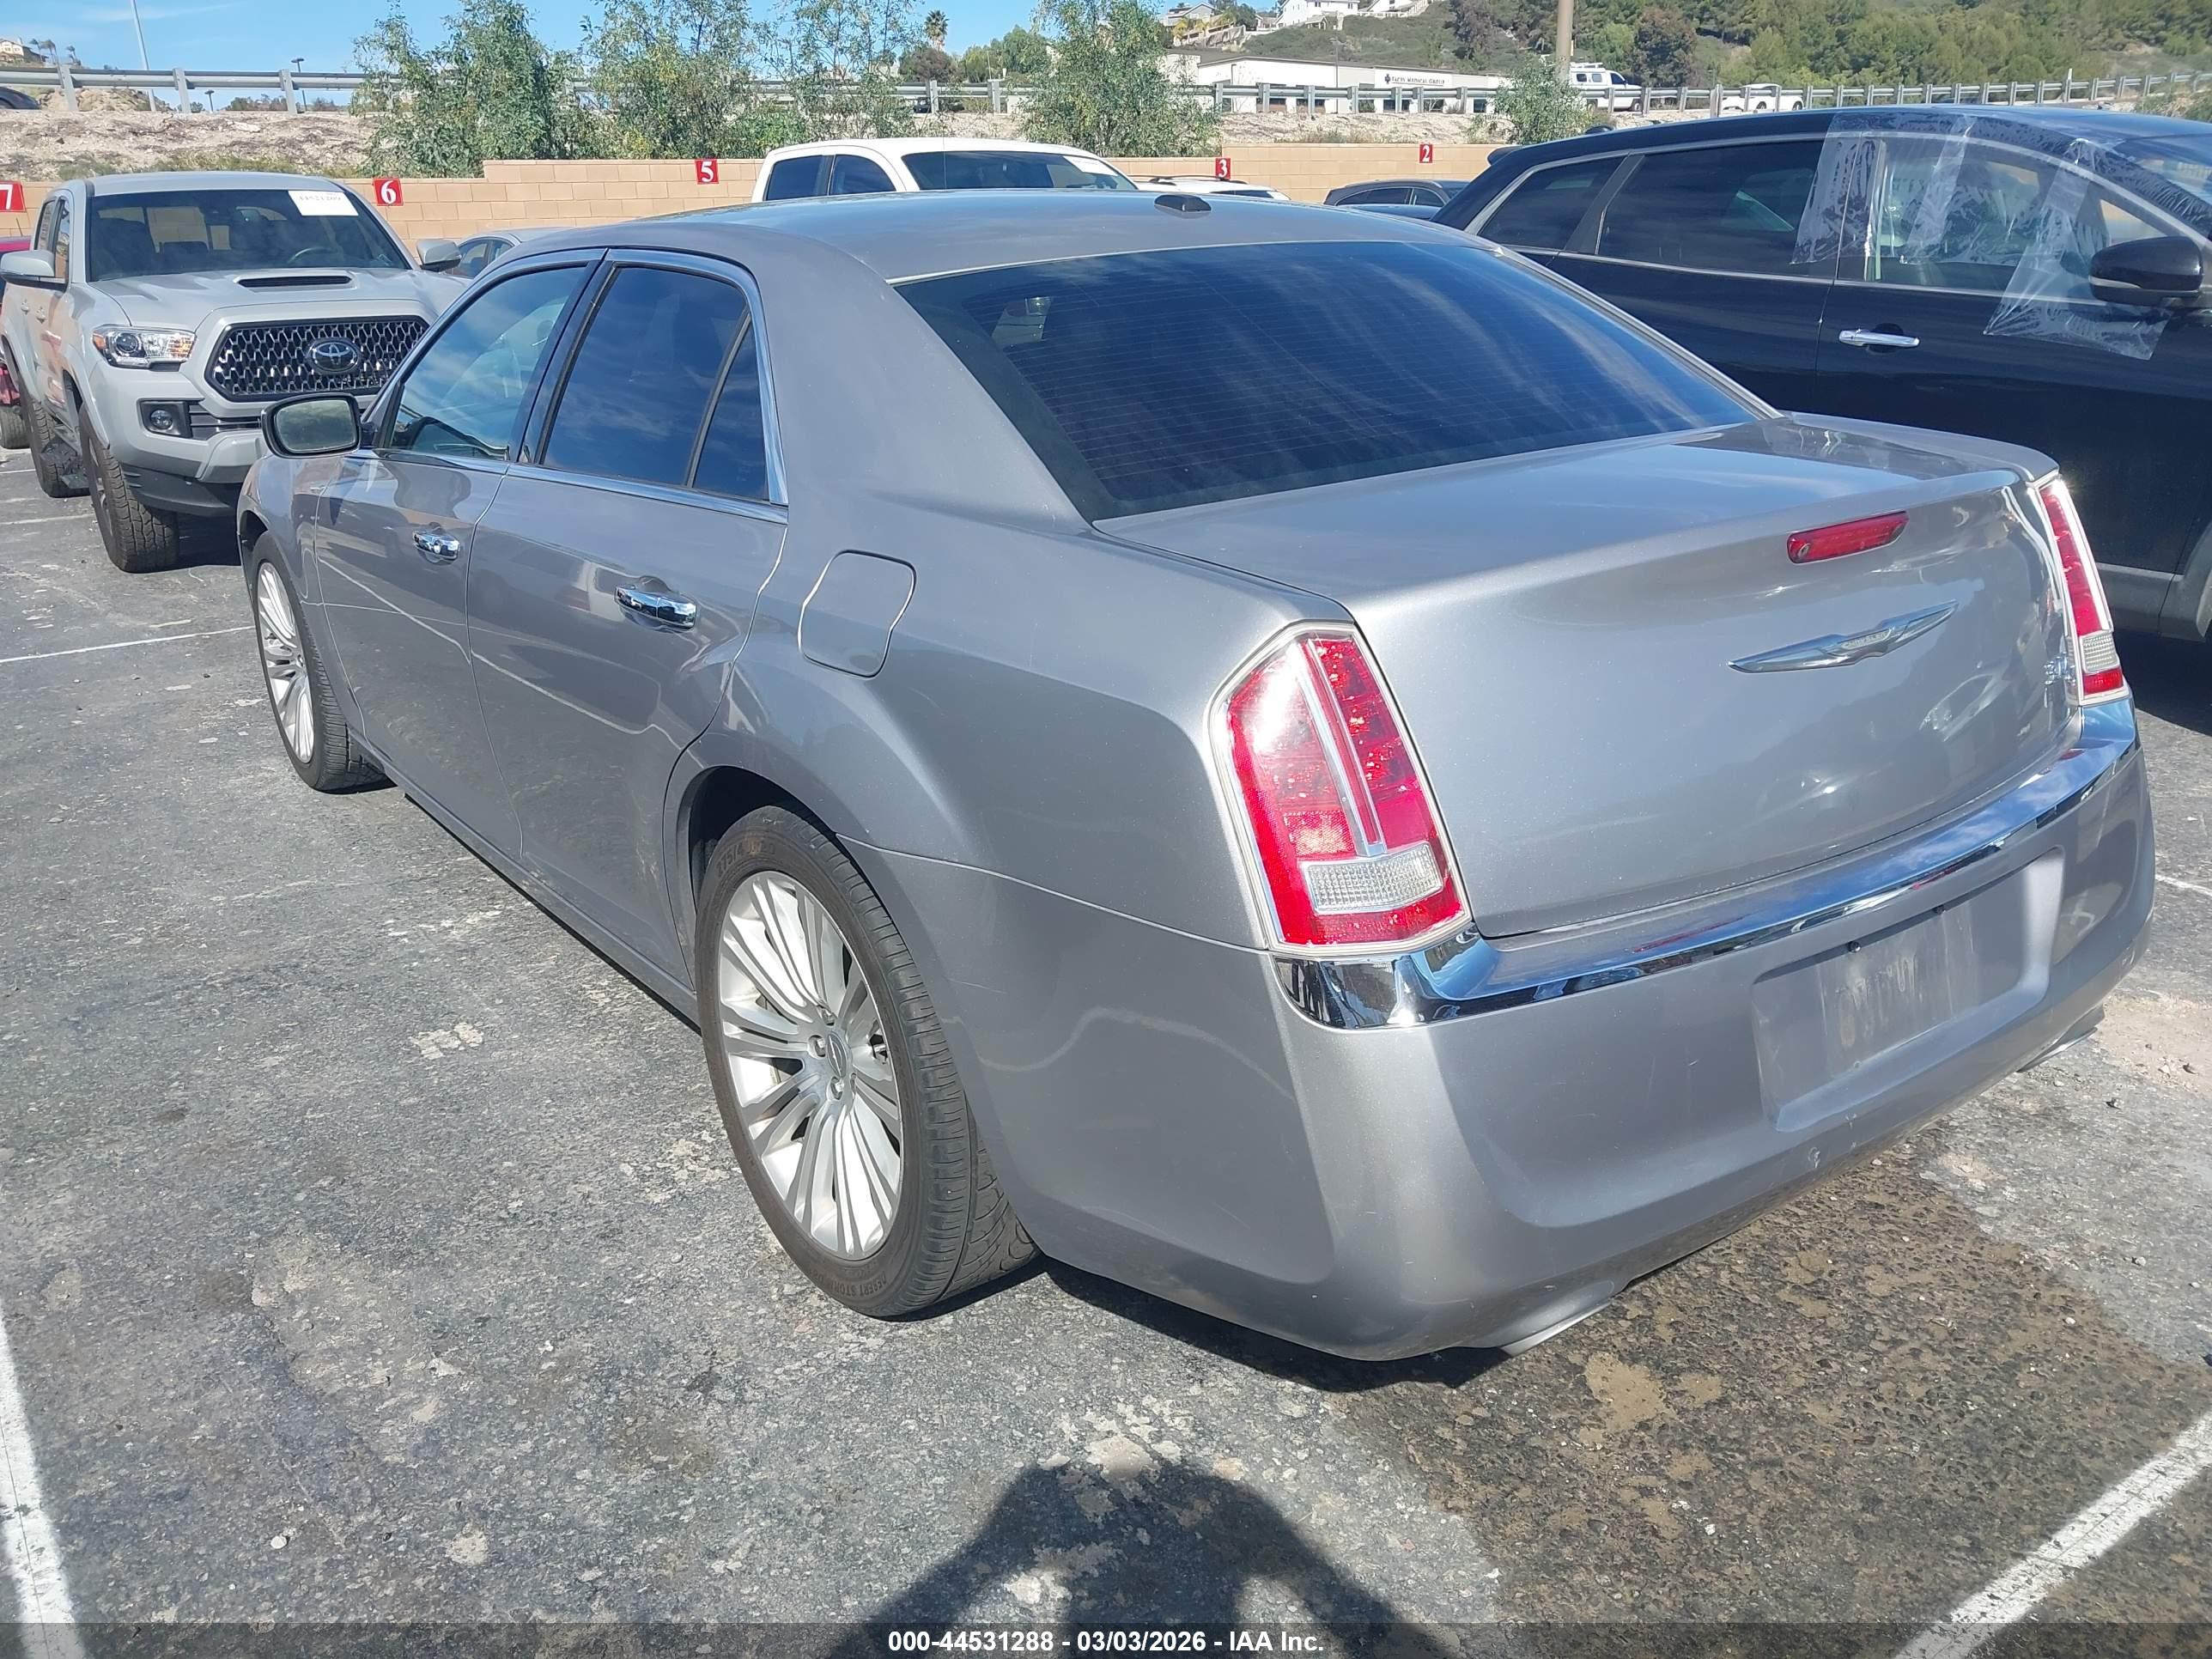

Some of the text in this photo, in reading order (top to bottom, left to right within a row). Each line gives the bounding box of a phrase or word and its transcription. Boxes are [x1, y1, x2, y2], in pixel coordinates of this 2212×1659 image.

[1422, 144, 1431, 162] 2
[701, 161, 714, 182] 5
[1218, 159, 1228, 177] 3
[0, 184, 14, 210] 7
[380, 180, 397, 204] 6
